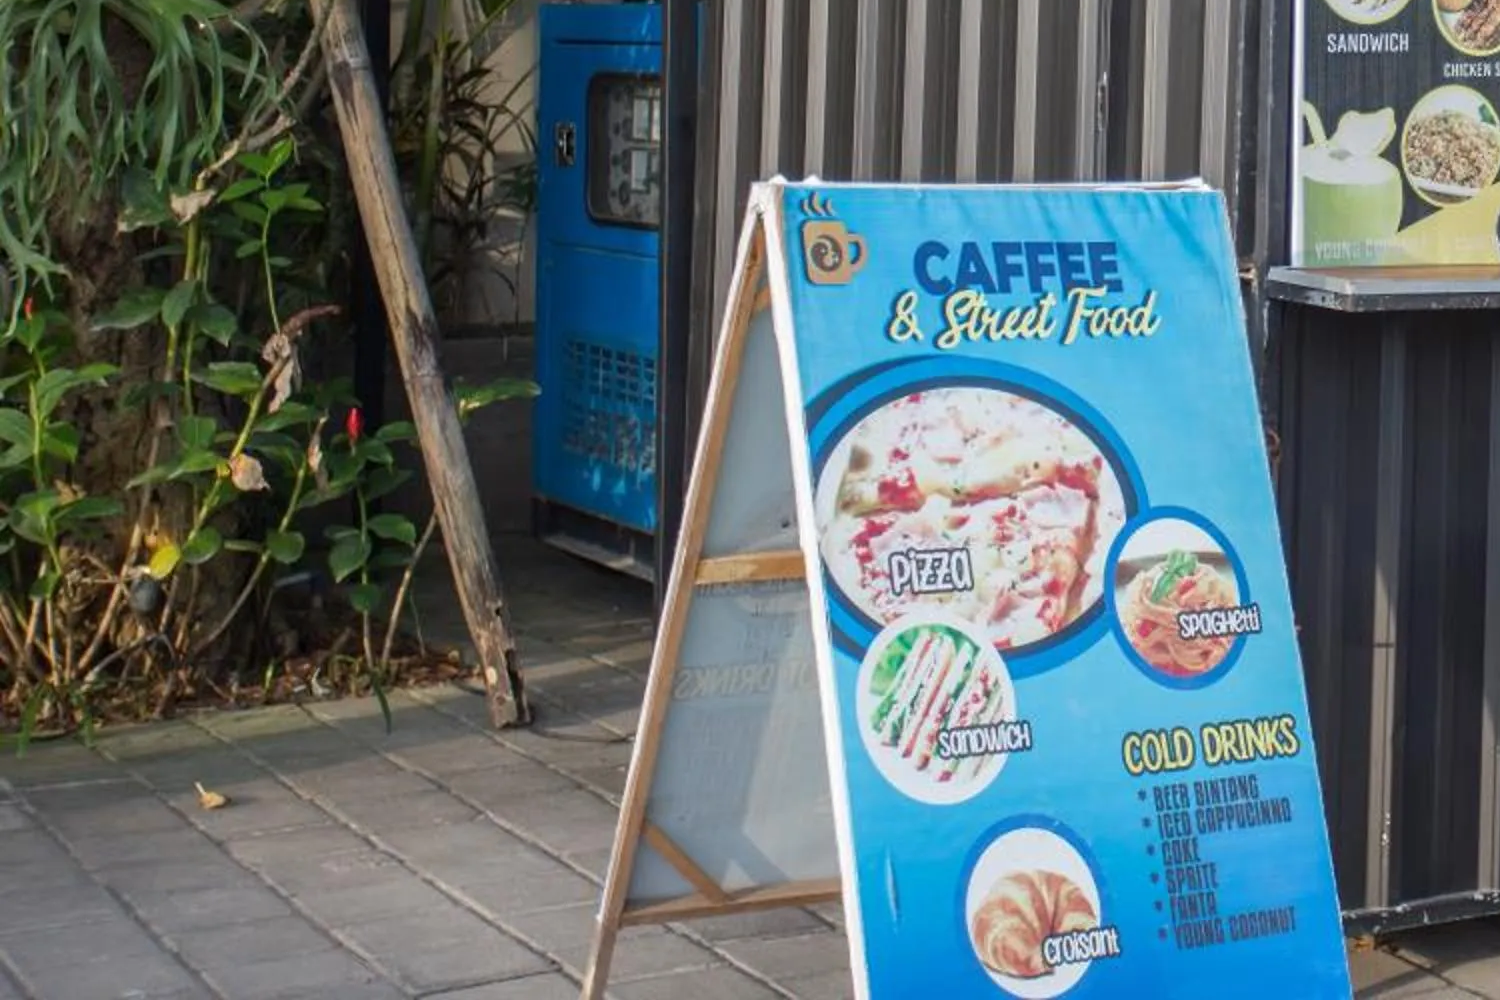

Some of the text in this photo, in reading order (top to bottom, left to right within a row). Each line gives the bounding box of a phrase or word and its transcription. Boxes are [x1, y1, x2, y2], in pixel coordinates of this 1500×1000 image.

[1327, 32, 1409, 54] SANDWICH
[1443, 62, 1491, 78] CHICKEN
[913, 239, 1125, 296] CAFFEE
[888, 286, 1162, 351] & Street Food
[1122, 714, 1300, 776] COLD DRINKS
[1153, 774, 1260, 812] BEER BINTANG
[1158, 811, 1193, 840] ICED
[1161, 837, 1201, 867] COKE
[1165, 861, 1219, 894] SPRITE
[1169, 890, 1218, 923] FANTA
[1174, 905, 1297, 951] YOUNG COCONUT
